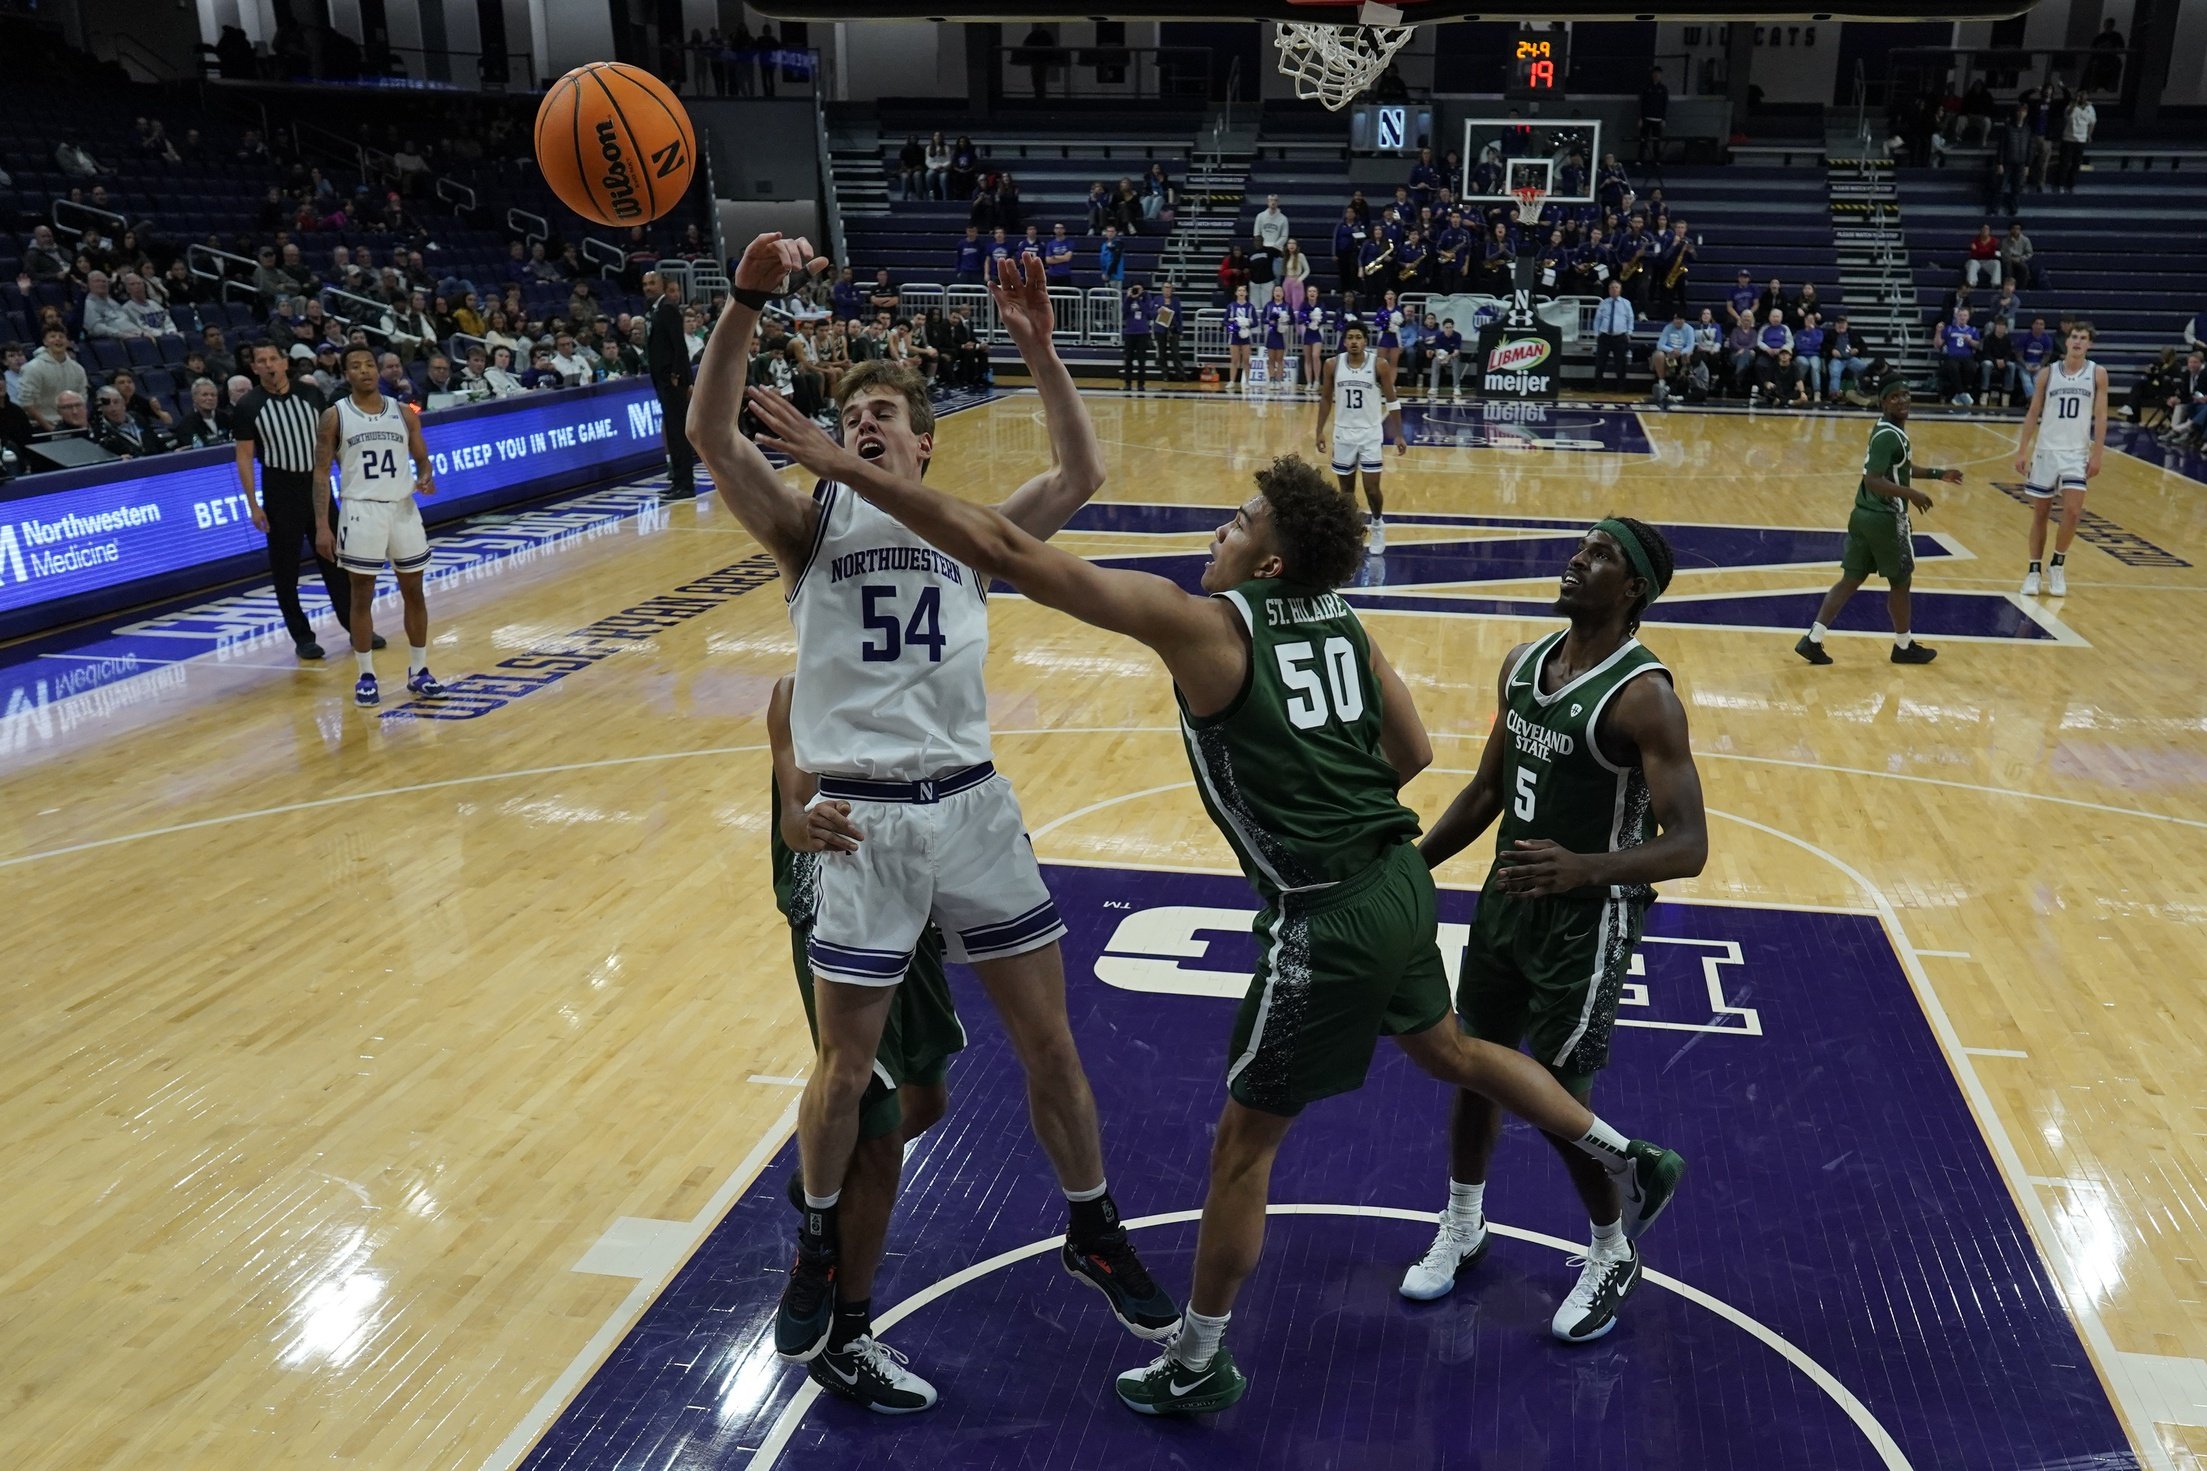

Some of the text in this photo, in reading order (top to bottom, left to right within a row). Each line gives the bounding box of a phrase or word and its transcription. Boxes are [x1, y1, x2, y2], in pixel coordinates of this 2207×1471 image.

[1684, 26, 1816, 46] WILCATS
[1530, 60, 1554, 89] 19
[1379, 108, 1405, 148] N
[596, 119, 643, 219] Wilson
[651, 139, 686, 179] N
[1515, 289, 1530, 310] N
[1488, 342, 1545, 371] LIBMAN
[1345, 389, 1363, 409] 13
[1484, 369, 1551, 397] meijer
[2058, 397, 2080, 419] 10
[346, 430, 405, 449] NORTHWESTERN
[451, 443, 493, 472] KEEP
[496, 435, 528, 462] YOU
[530, 432, 547, 455] IN
[548, 425, 576, 450] THE
[577, 418, 619, 443] GAME.
[362, 449, 397, 480] 24
[21, 503, 162, 547] Northwestern
[30, 538, 120, 578] Medicine
[831, 546, 963, 587] NORTHWESTERN
[861, 585, 947, 662] 54
[1265, 592, 1348, 626] ST. HILAIRE
[1274, 636, 1364, 730] 50
[1506, 708, 1574, 756] CLEVELAND
[919, 782, 933, 801] N
[1514, 765, 1538, 823] 5
